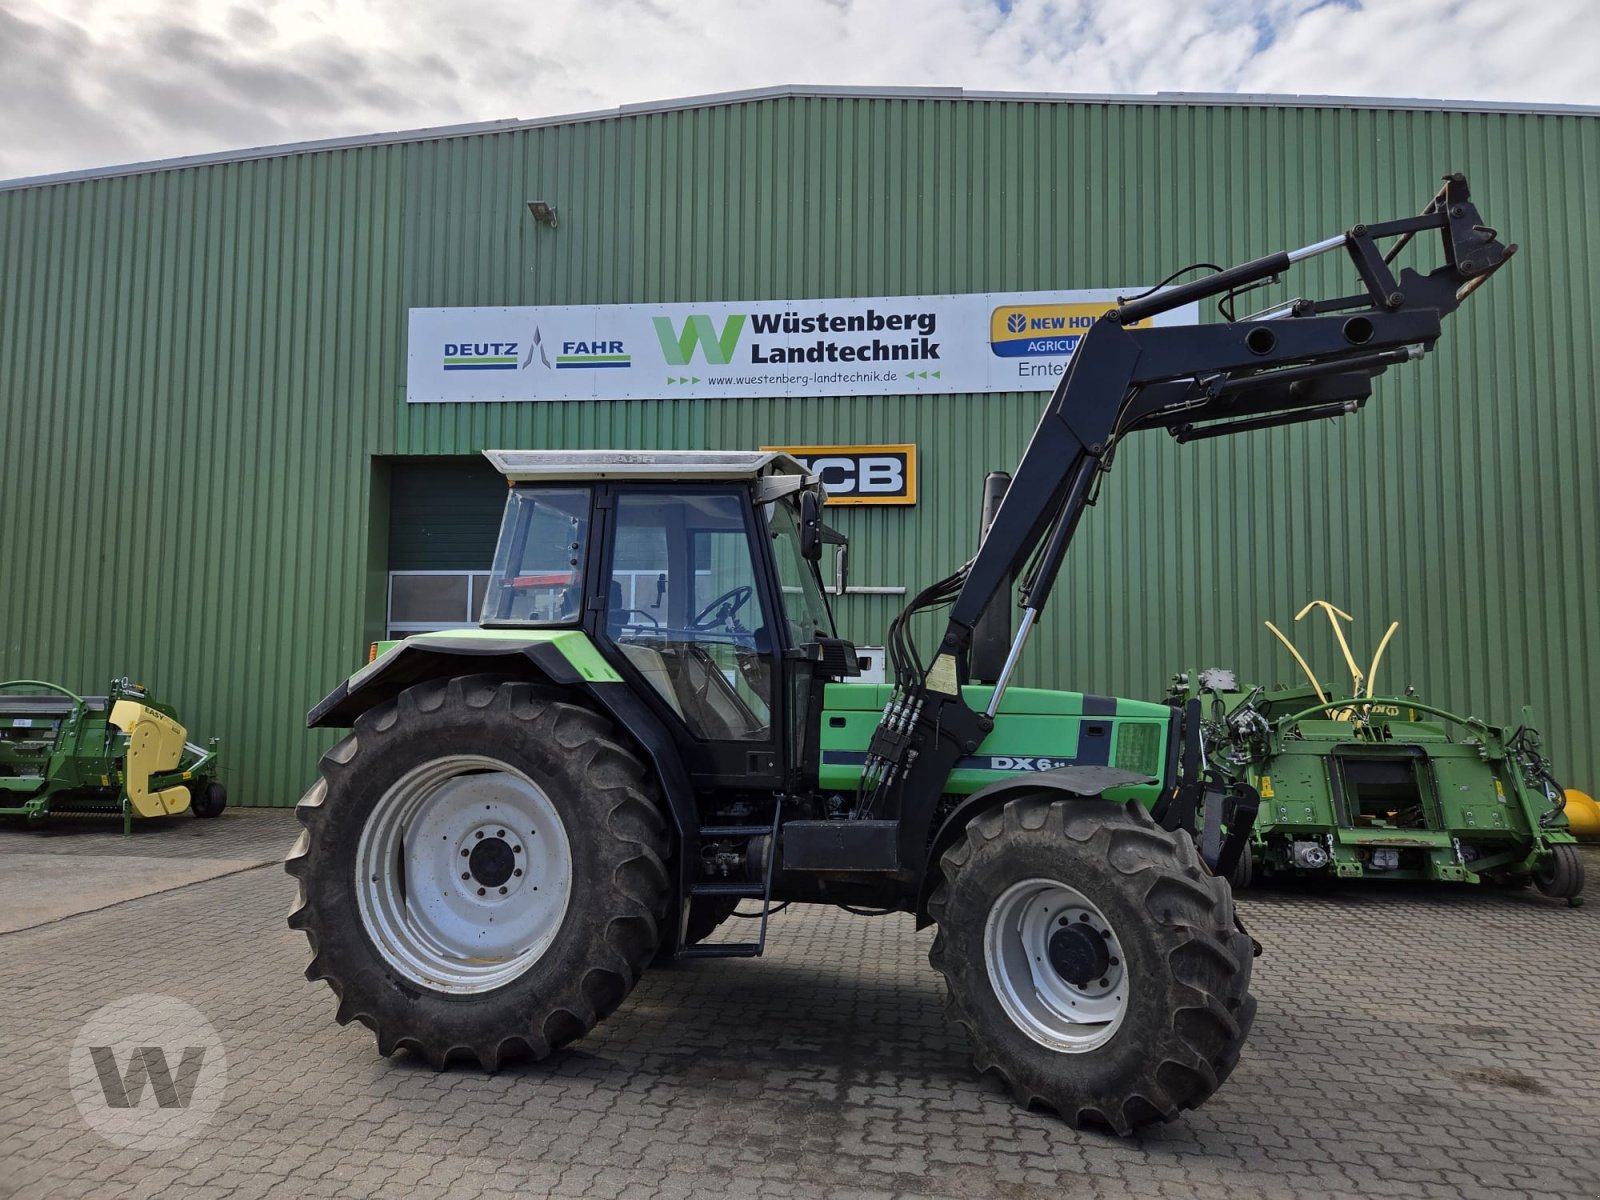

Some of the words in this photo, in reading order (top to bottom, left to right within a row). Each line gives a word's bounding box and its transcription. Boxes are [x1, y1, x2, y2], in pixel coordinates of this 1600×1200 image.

[751, 309, 937, 336] Wüstenberg
[1030, 317, 1066, 330] NEW
[444, 343, 519, 356] DEUTZ
[563, 341, 624, 355] FAHR
[751, 338, 941, 364] Landtechnik
[708, 371, 898, 387] www.wuestenberg-landtechnik.de
[797, 457, 904, 493] CB
[144, 706, 165, 721] EASY
